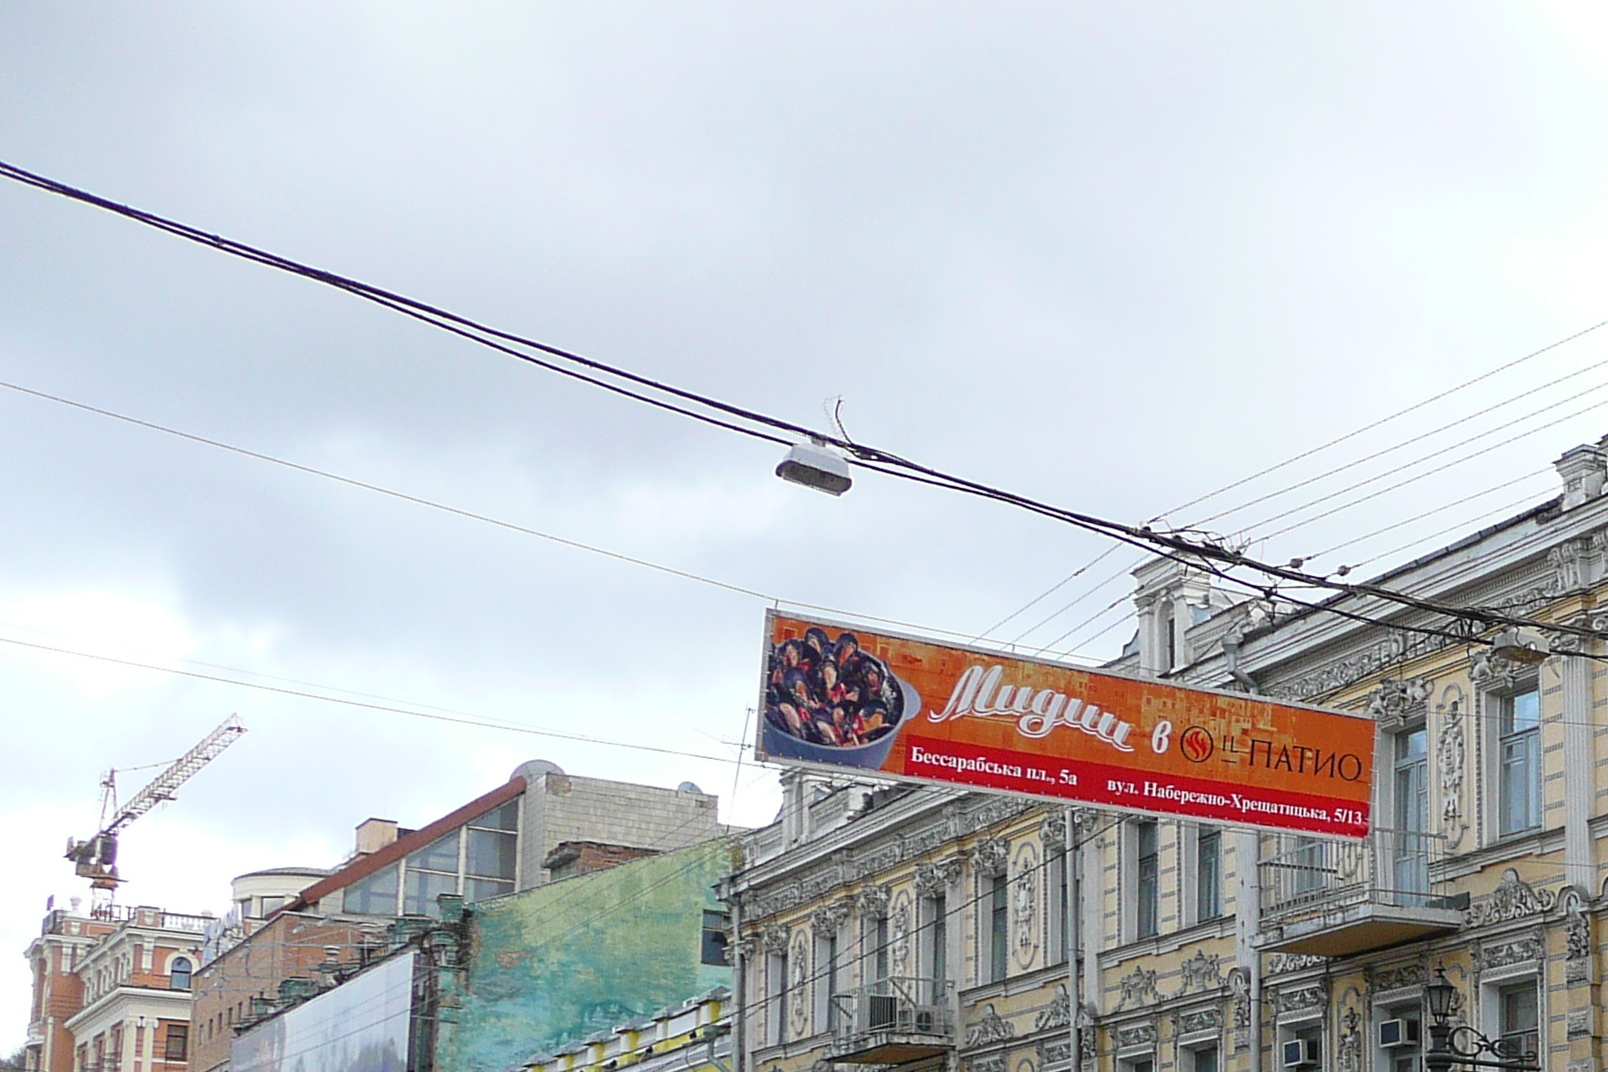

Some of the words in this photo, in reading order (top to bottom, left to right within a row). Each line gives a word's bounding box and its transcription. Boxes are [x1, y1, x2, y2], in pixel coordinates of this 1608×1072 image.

[927, 664, 1134, 753] Мидии
[1151, 720, 1172, 754] в
[910, 745, 1022, 778] Бессарабська
[1059, 769, 1078, 785] 5а
[1249, 738, 1363, 783] ПАТИО
[1107, 779, 1139, 796] вул.
[1143, 781, 1331, 823] Набережно-Хрещатицька,
[1333, 808, 1363, 825] 5/13
